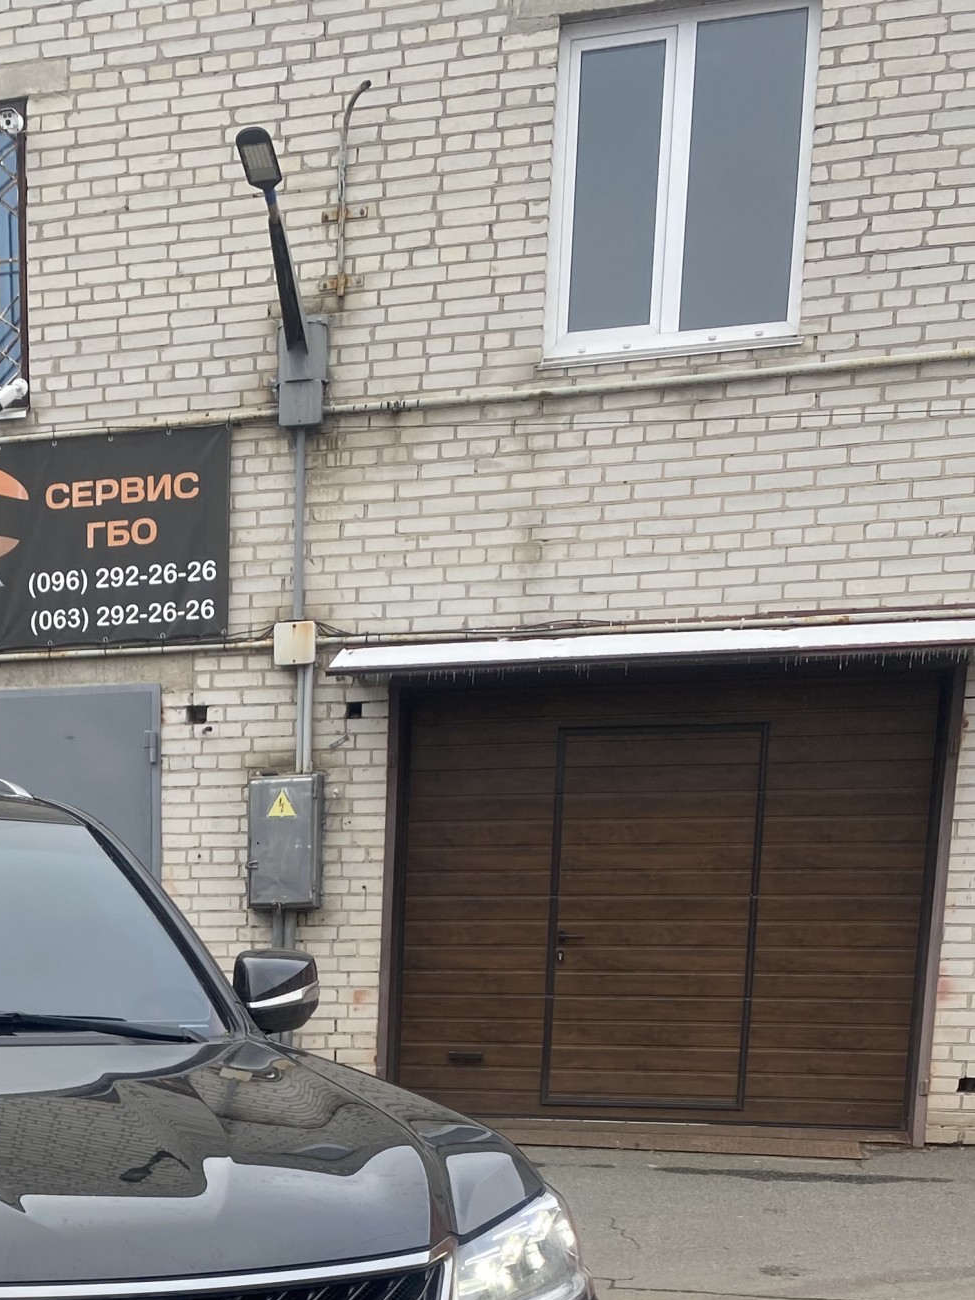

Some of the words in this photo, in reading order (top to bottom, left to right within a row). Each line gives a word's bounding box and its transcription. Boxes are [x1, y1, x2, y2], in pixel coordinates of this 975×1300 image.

[45, 471, 200, 510] СЕРВИС
[86, 517, 158, 549] ГБО
[28, 569, 88, 598] (096)
[95, 560, 217, 589] 292-26-26
[30, 607, 89, 636] (063)
[96, 599, 215, 627] 292-26-26
